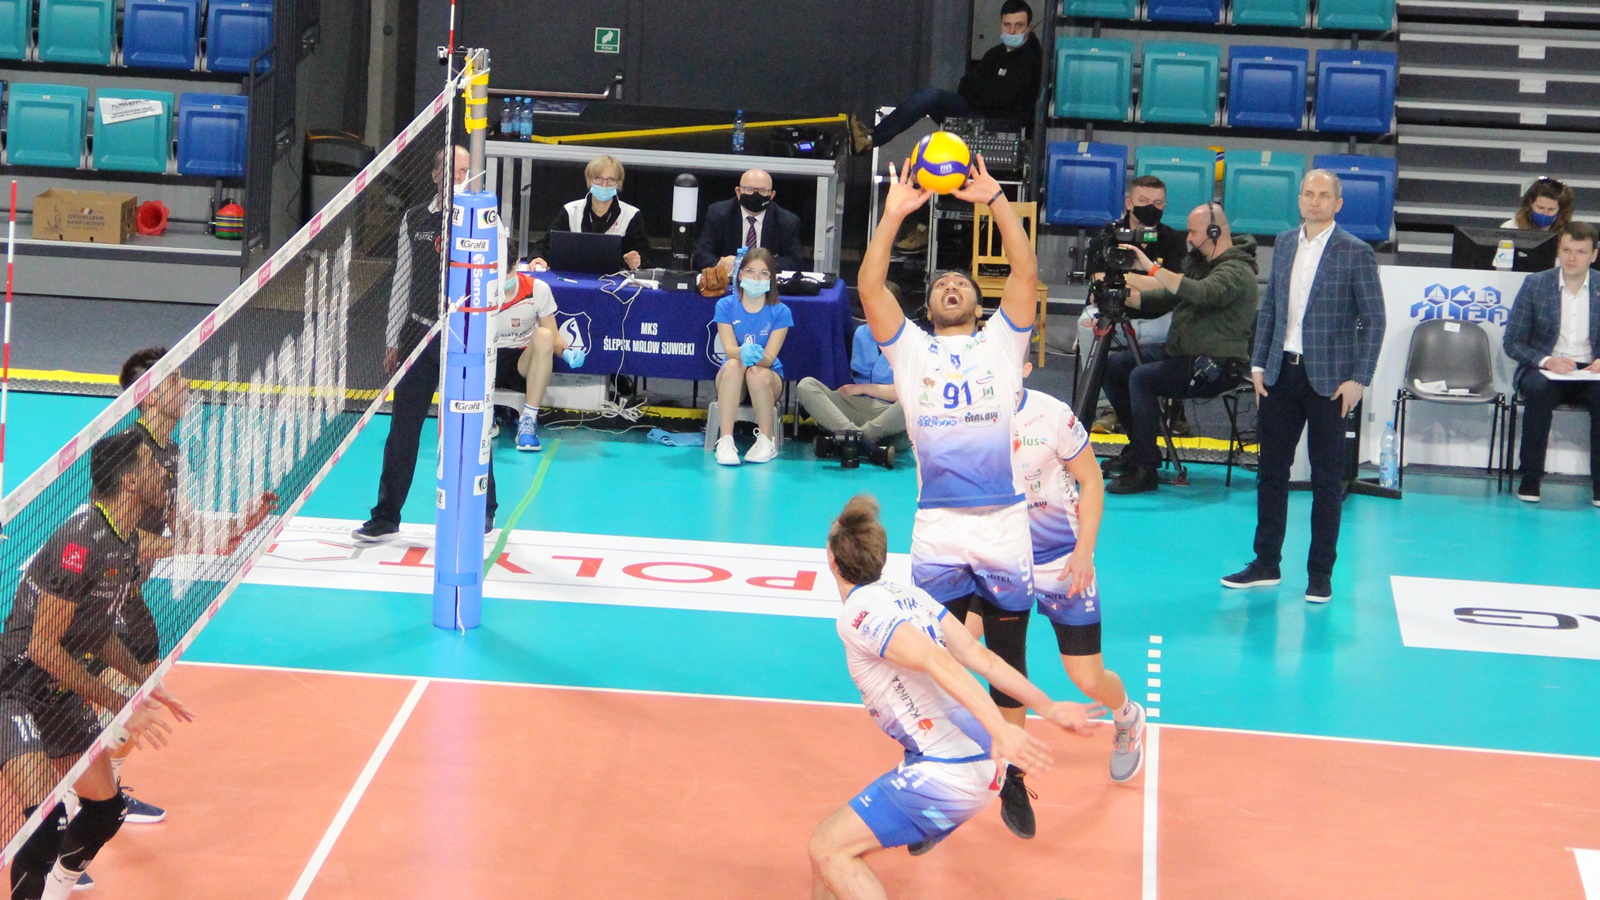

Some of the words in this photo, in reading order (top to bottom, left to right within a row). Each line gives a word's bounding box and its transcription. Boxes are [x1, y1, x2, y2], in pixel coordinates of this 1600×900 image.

[463, 239, 486, 249] Grafit
[641, 322, 658, 335] MKS
[603, 336, 631, 351] ŚLEPSK
[632, 340, 660, 354] MALOW
[662, 342, 695, 356] SUWAŁKI
[943, 380, 972, 409] 91
[456, 401, 480, 411] Grafit
[965, 411, 998, 424] MALOW
[892, 675, 921, 719] KALINKA
